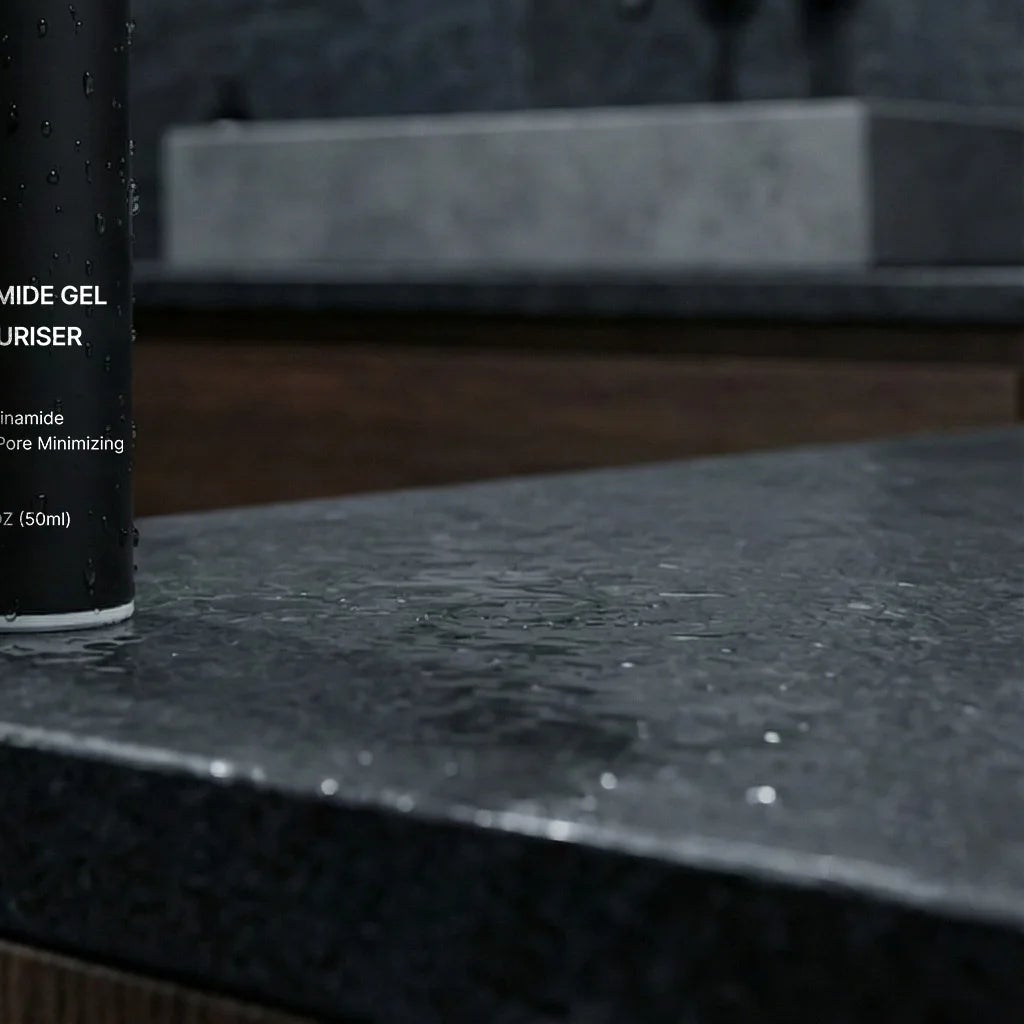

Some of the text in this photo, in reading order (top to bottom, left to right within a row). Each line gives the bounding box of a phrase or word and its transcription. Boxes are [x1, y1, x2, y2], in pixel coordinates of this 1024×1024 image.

[61, 285, 107, 305] GEL
[38, 436, 124, 454] Minimizing
[19, 510, 71, 528] (50ml)
